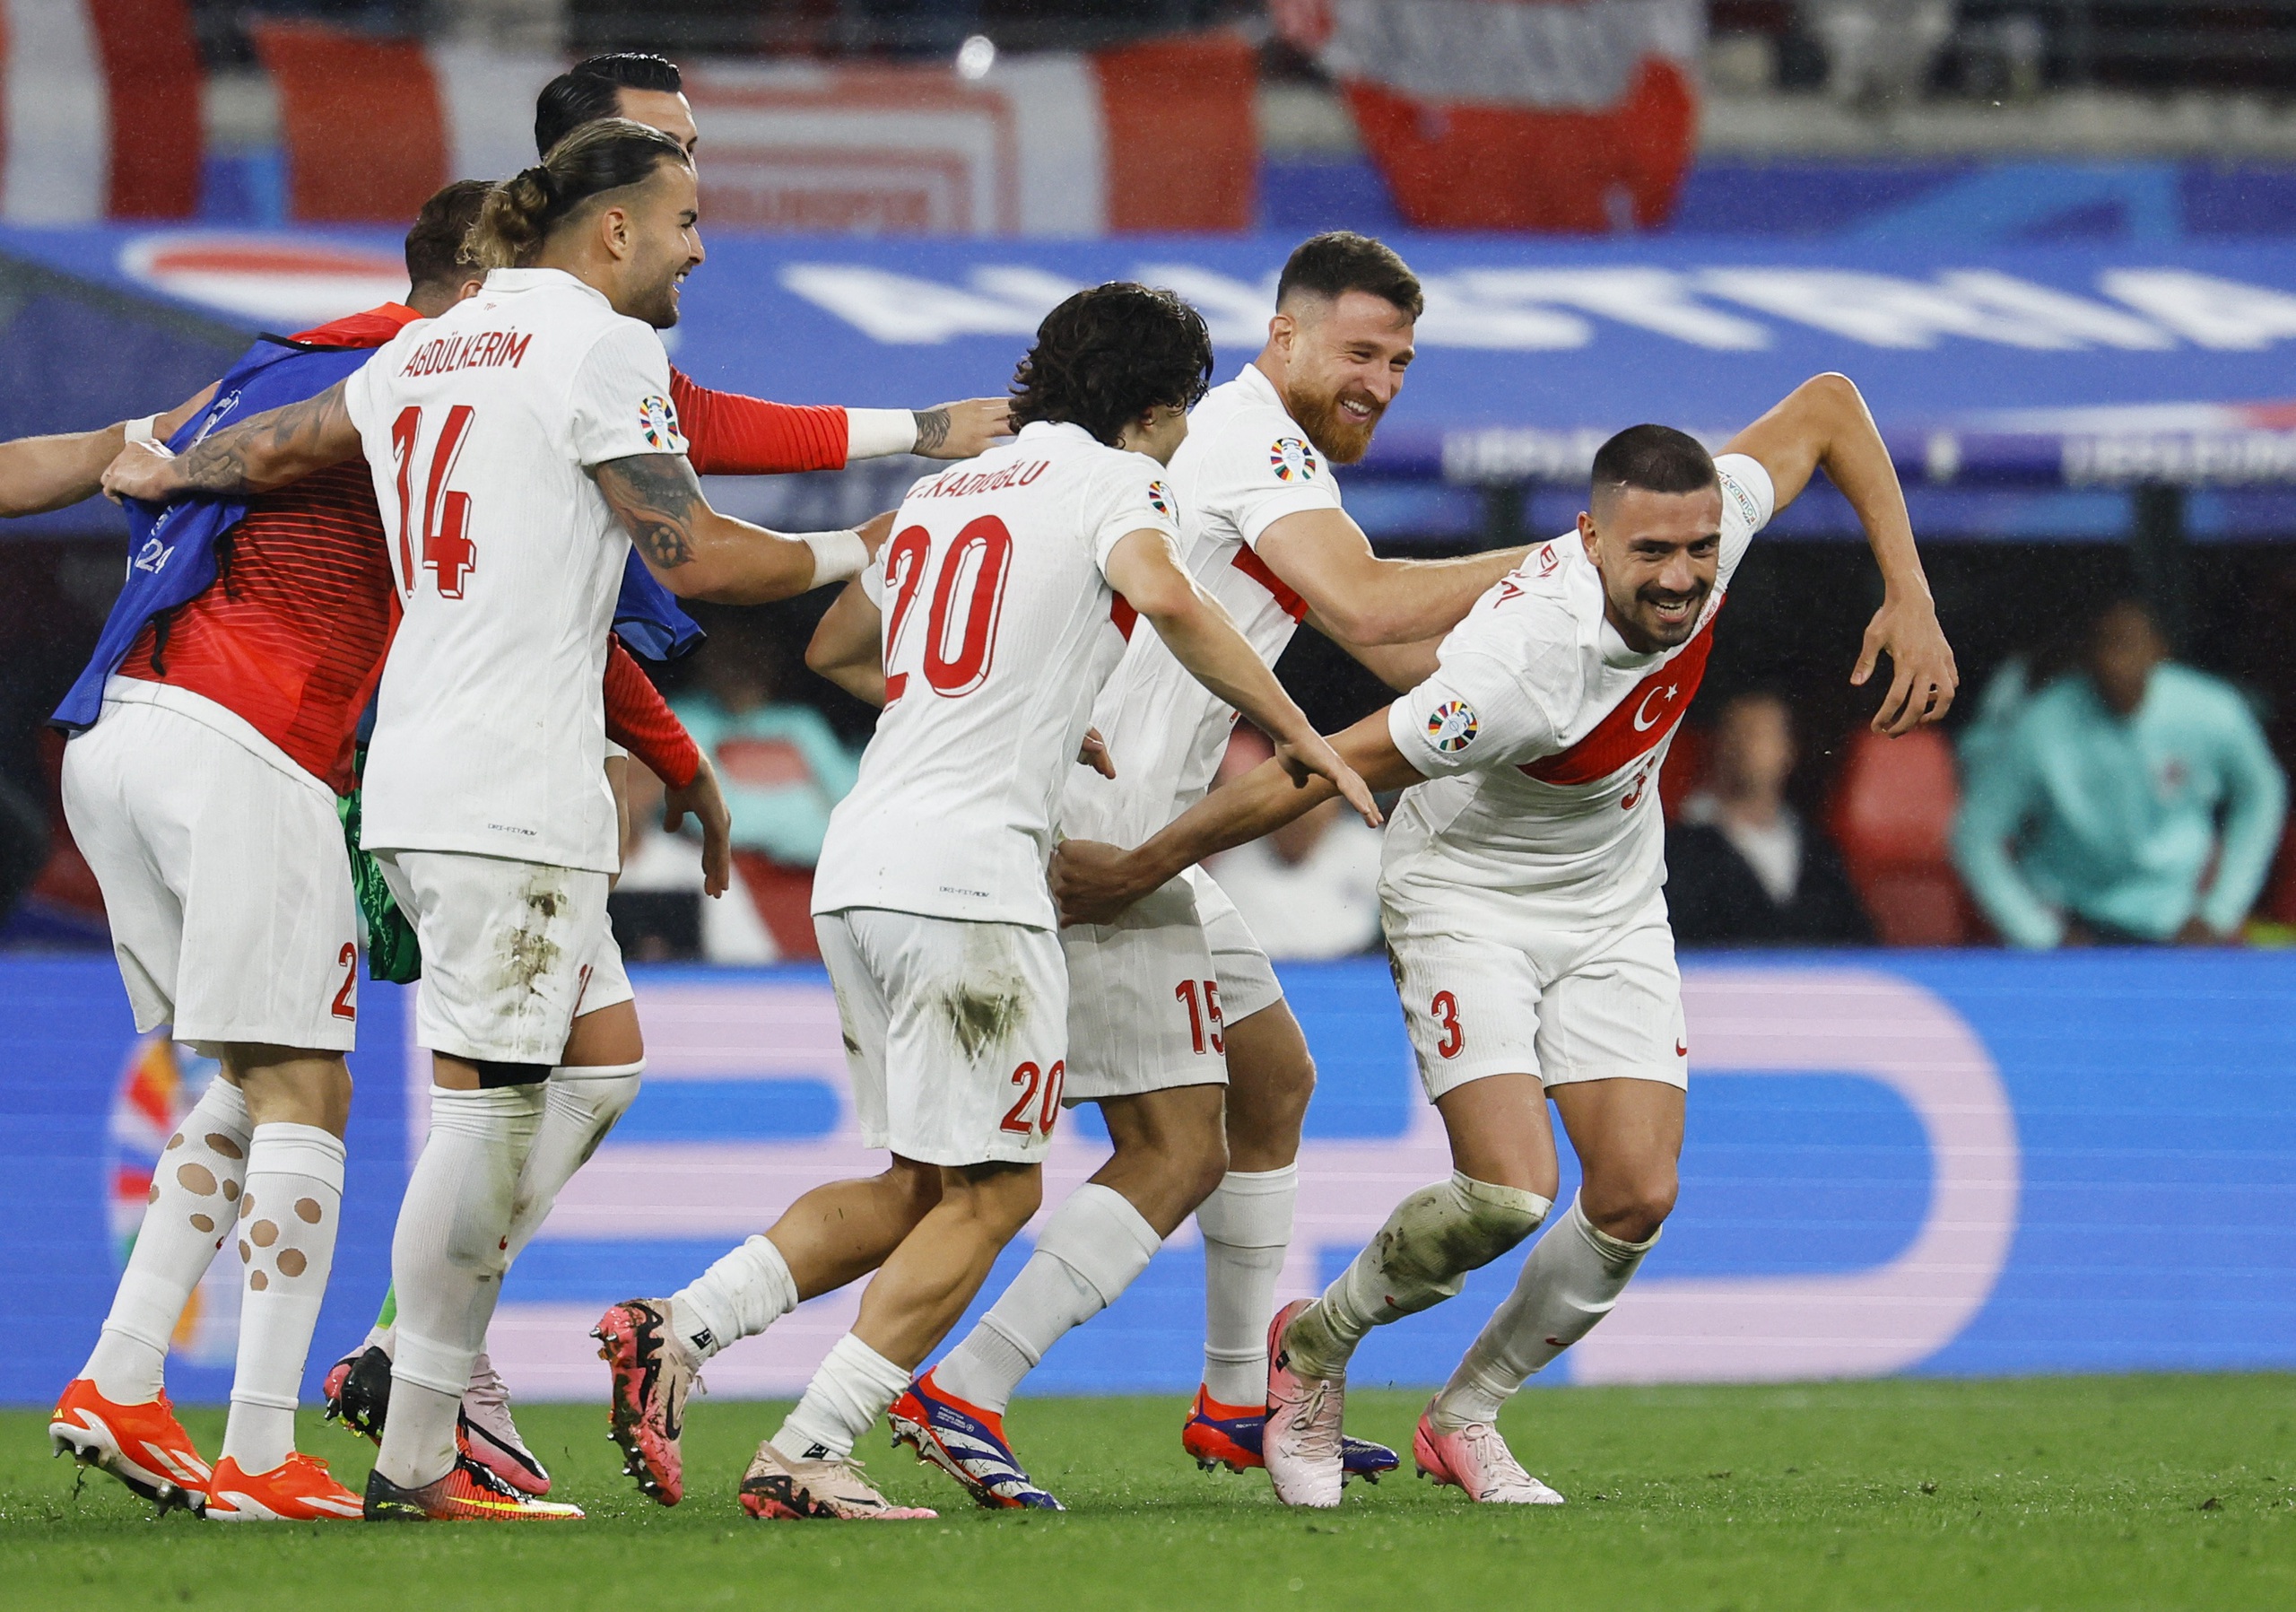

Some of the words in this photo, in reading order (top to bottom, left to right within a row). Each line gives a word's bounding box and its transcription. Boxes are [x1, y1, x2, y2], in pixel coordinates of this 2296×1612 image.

[399, 326, 533, 378] ABDÜLKERİM
[392, 405, 477, 600] 14
[884, 514, 1013, 713] 20
[1175, 979, 1225, 1056] 15
[1431, 989, 1465, 1059] 3
[1000, 1059, 1065, 1136] 20
